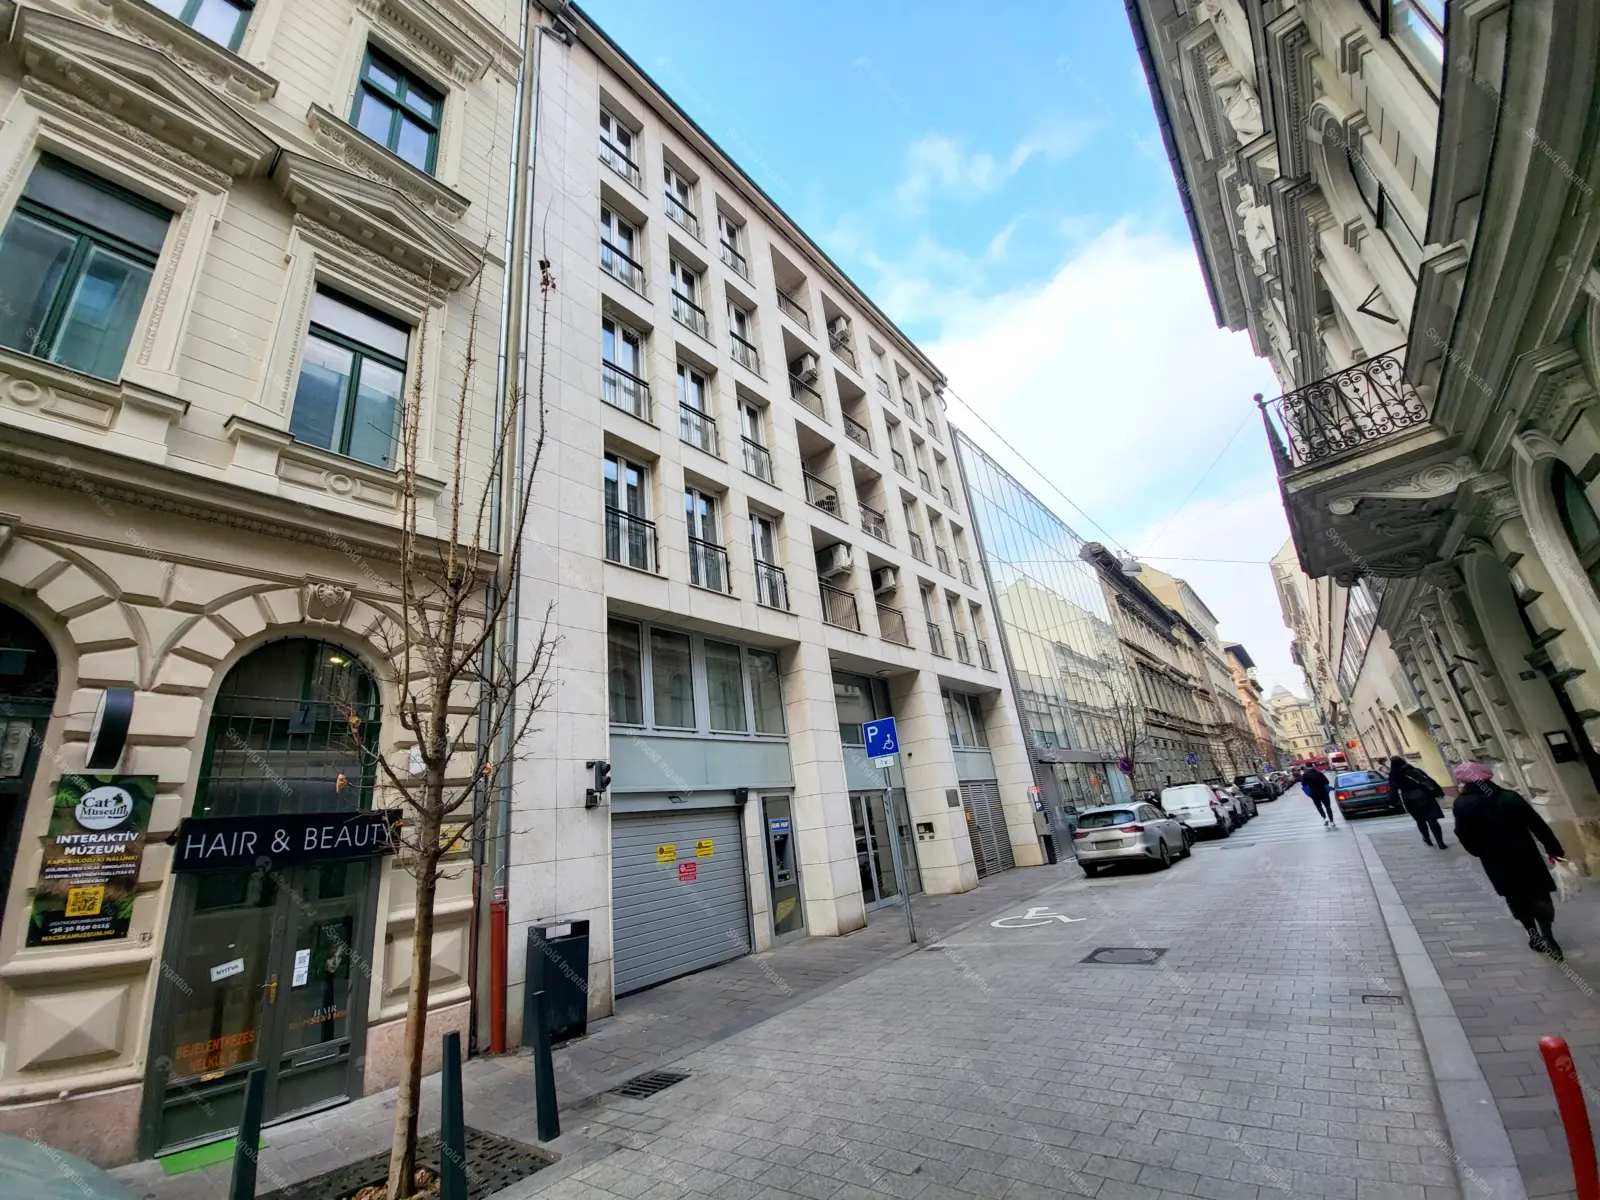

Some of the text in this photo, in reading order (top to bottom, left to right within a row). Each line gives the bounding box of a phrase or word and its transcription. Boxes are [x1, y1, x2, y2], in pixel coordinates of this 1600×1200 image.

[867, 726, 878, 743] P
[82, 797, 108, 808] Cat
[81, 805, 128, 816] Museum
[56, 831, 139, 844] INTERAKTÍV
[184, 823, 391, 860] HAIR & BEAUTY
[64, 844, 126, 856] MÚZEUM
